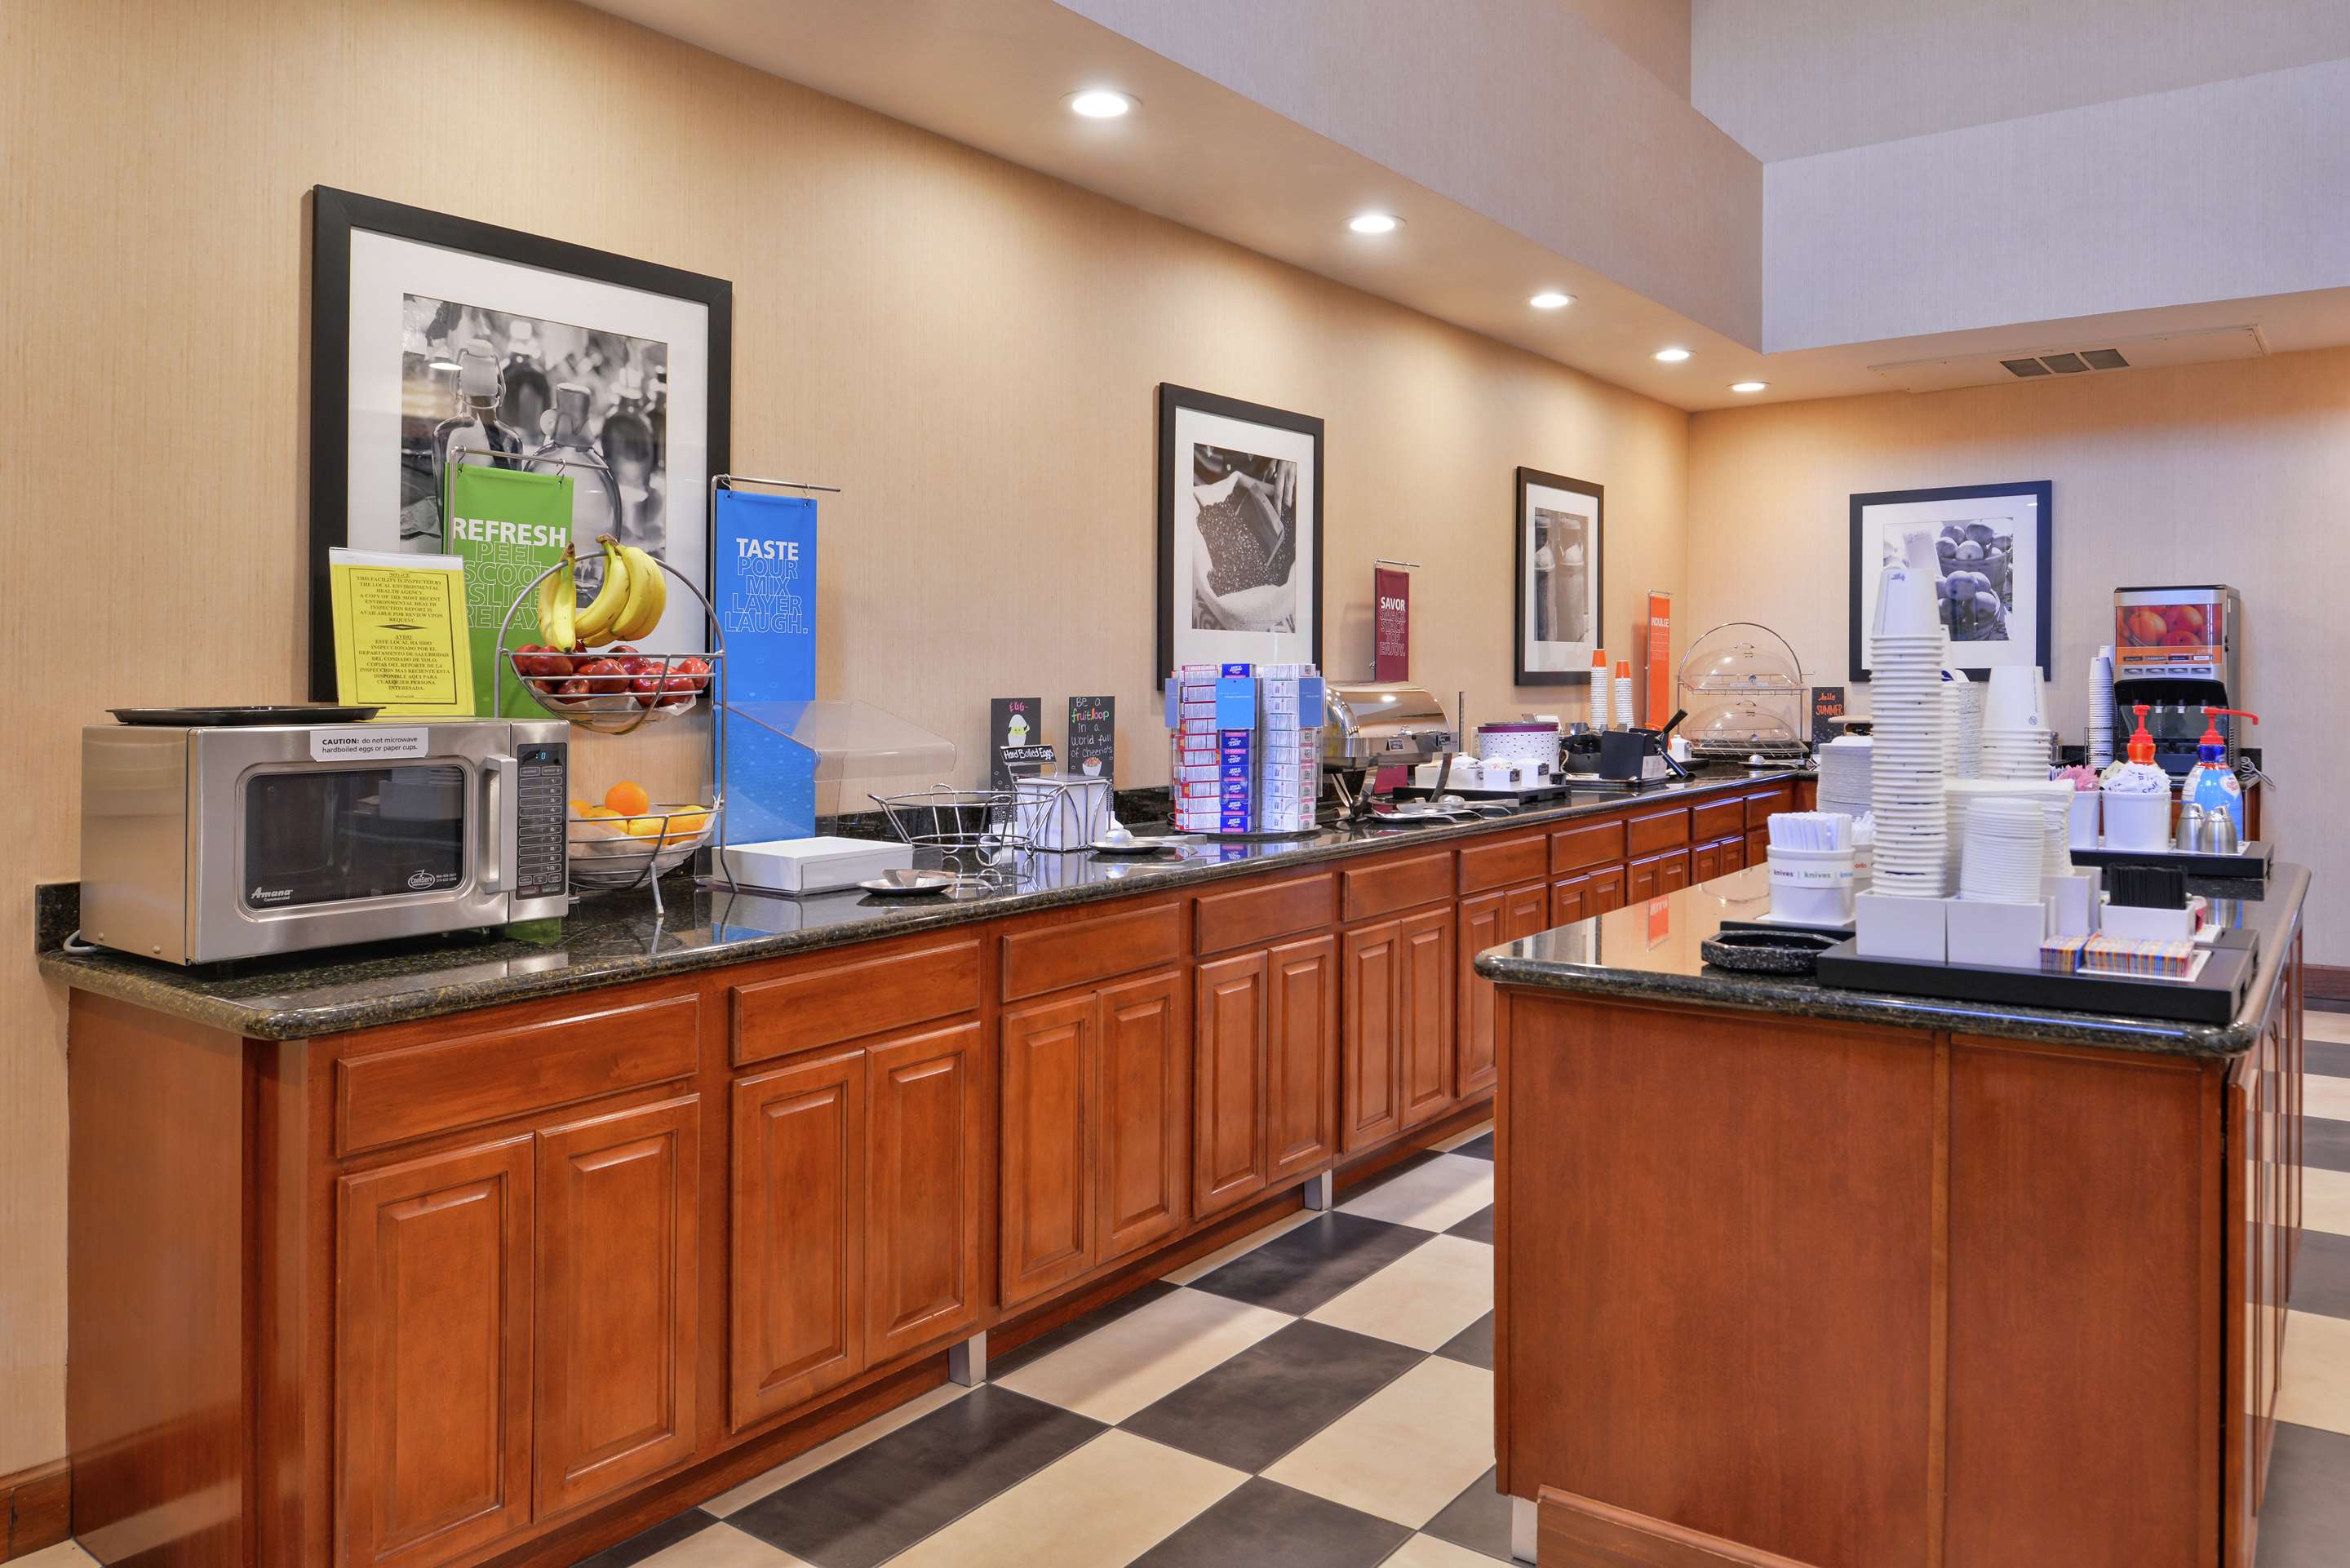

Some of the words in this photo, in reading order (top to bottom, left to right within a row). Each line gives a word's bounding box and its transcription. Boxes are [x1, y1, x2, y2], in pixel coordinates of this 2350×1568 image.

[453, 517, 566, 548] REFRESH
[476, 540, 542, 565] PEEL
[736, 538, 799, 560] TASTE
[738, 556, 798, 579] POUR
[746, 575, 790, 596] MIX
[733, 592, 802, 615] LAYER
[1381, 596, 1406, 611] SAVOR
[725, 611, 809, 634] LAUGH.
[1075, 698, 1089, 707] Be
[1095, 698, 1102, 706] a
[1816, 704, 1842, 715] SUMMER
[1077, 723, 1087, 733] in
[322, 737, 360, 746] CAUTION:
[1071, 735, 1095, 746] world
[1098, 734, 1111, 746] full
[1004, 749, 1019, 760] Hard
[1018, 748, 1039, 759] Boiled
[1038, 747, 1054, 760] Eggs
[1071, 748, 1080, 758] of
[1773, 870, 1794, 878] knives
[251, 887, 291, 899] Amana
